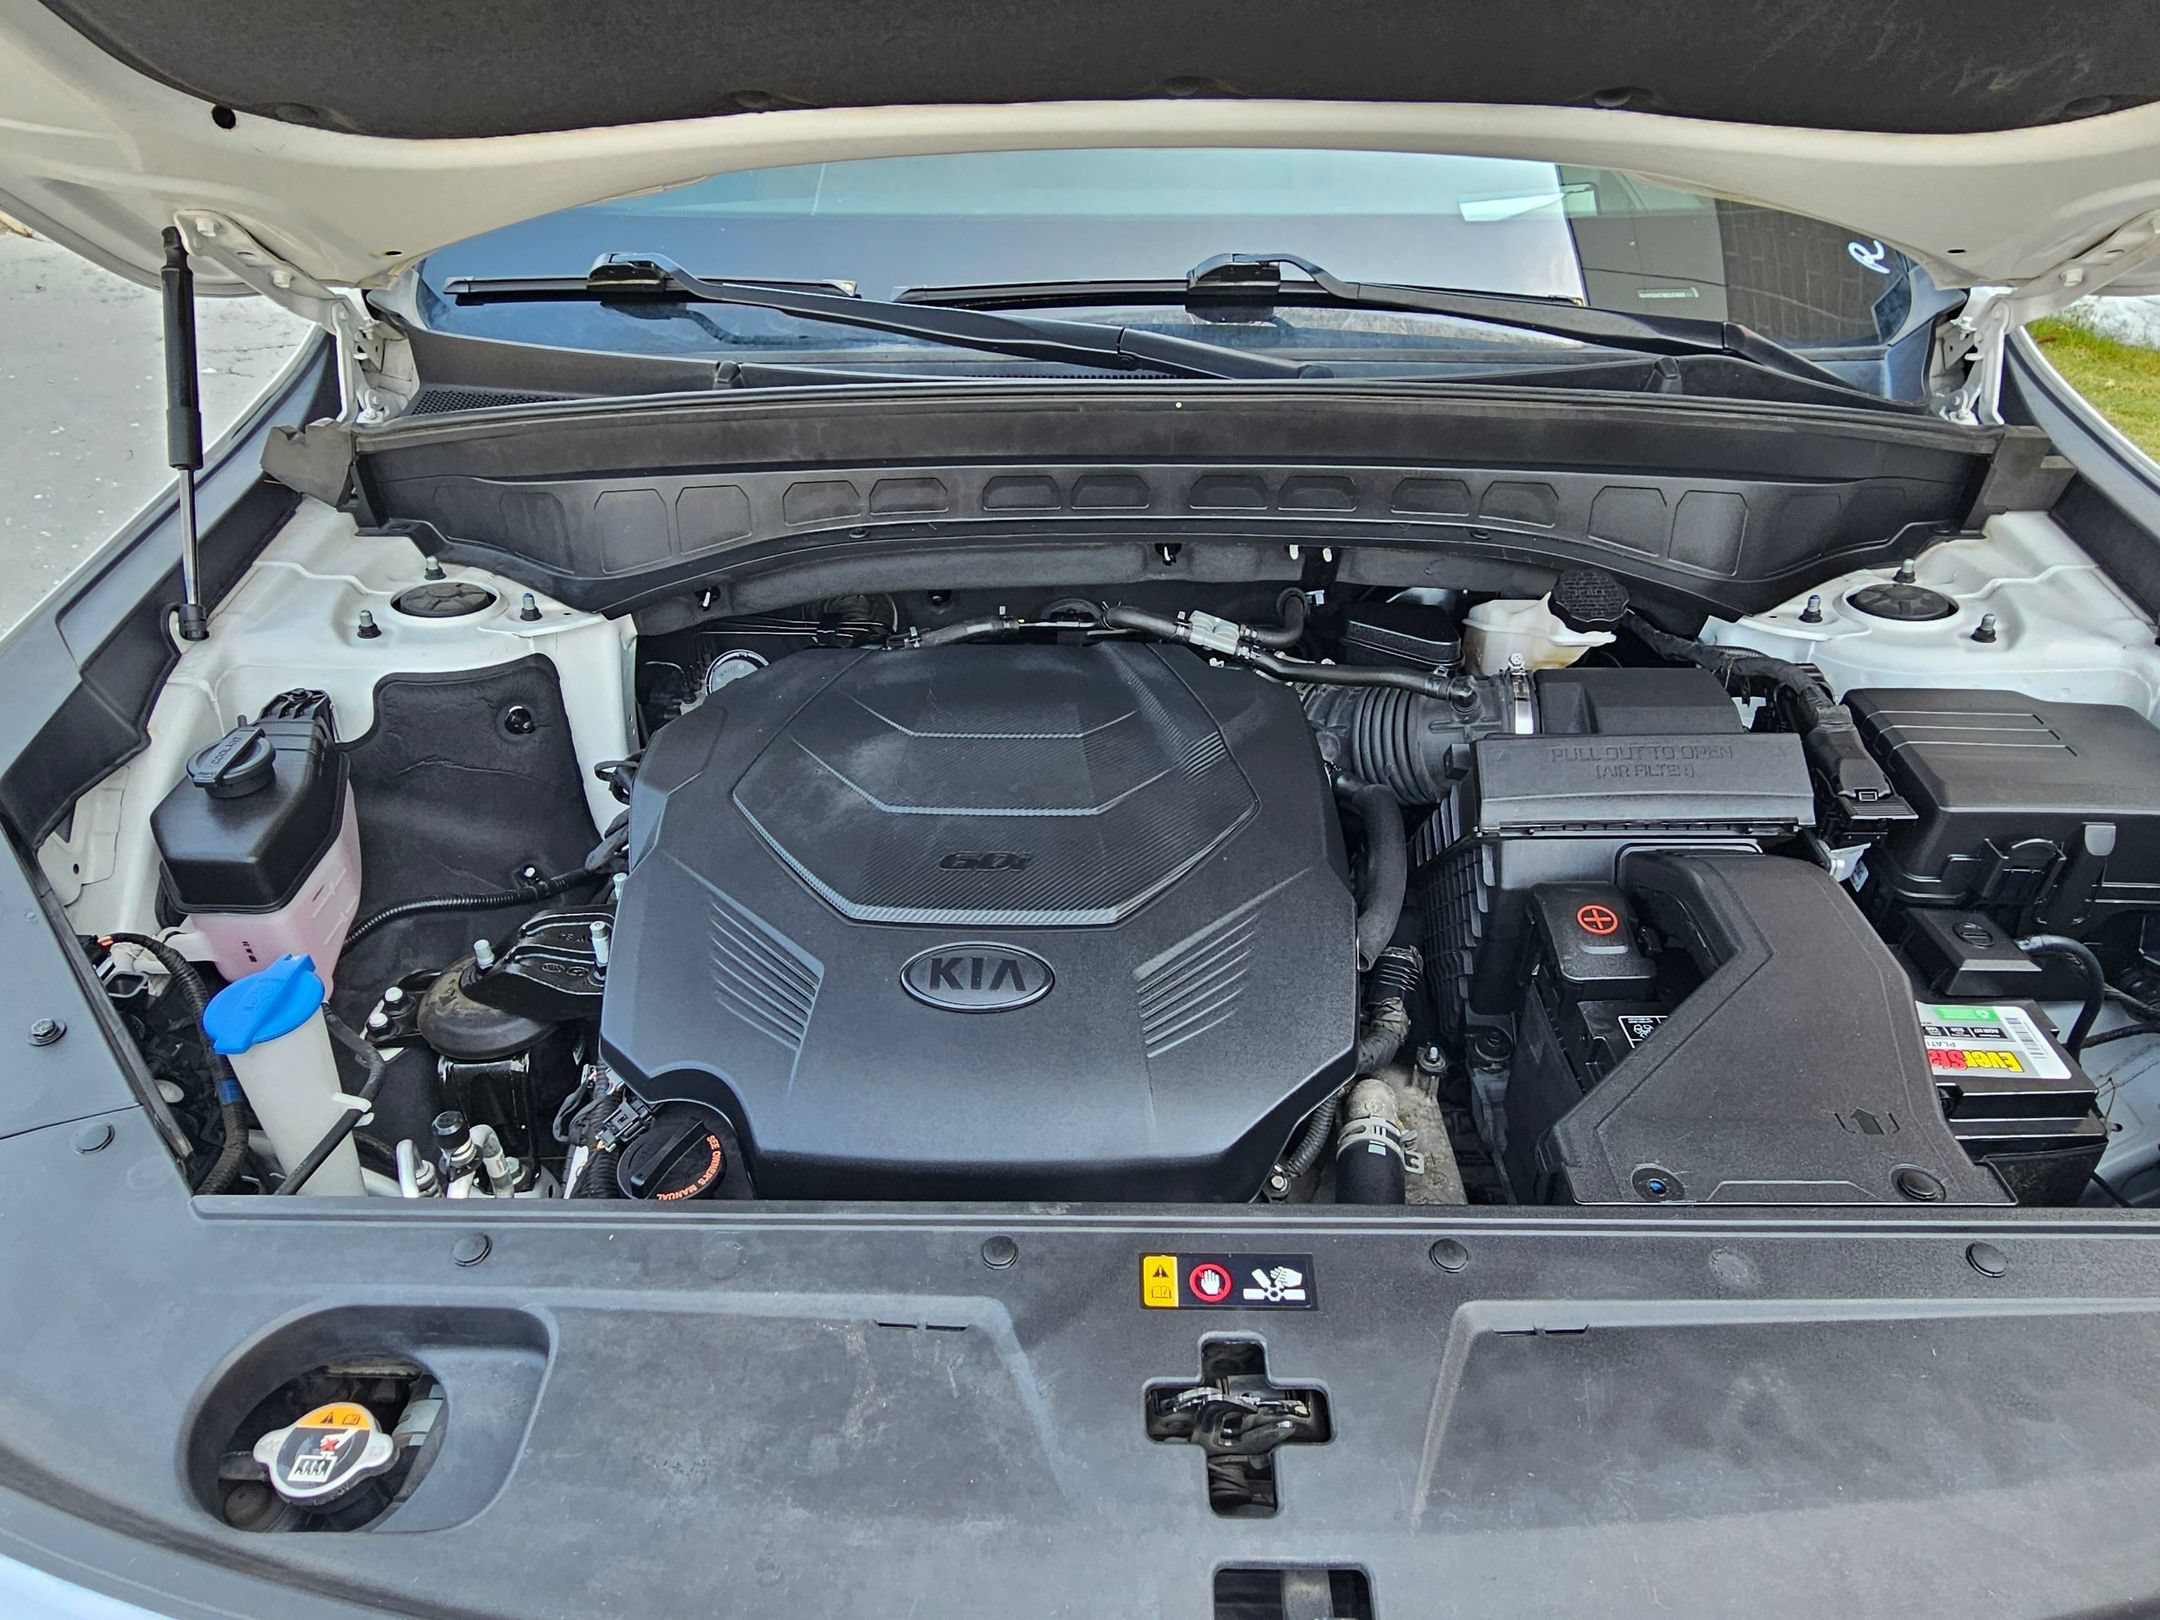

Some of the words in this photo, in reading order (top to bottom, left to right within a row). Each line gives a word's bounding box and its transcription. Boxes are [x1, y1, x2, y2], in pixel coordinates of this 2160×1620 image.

[1551, 746, 1602, 763] PULL
[1606, 745, 1645, 761] OUT
[1648, 745, 1676, 760] TO
[1681, 744, 1734, 760] OPEN
[928, 957, 1027, 992] KIA
[706, 1135, 721, 1150] SEE
[656, 1184, 698, 1200] MANUAL
